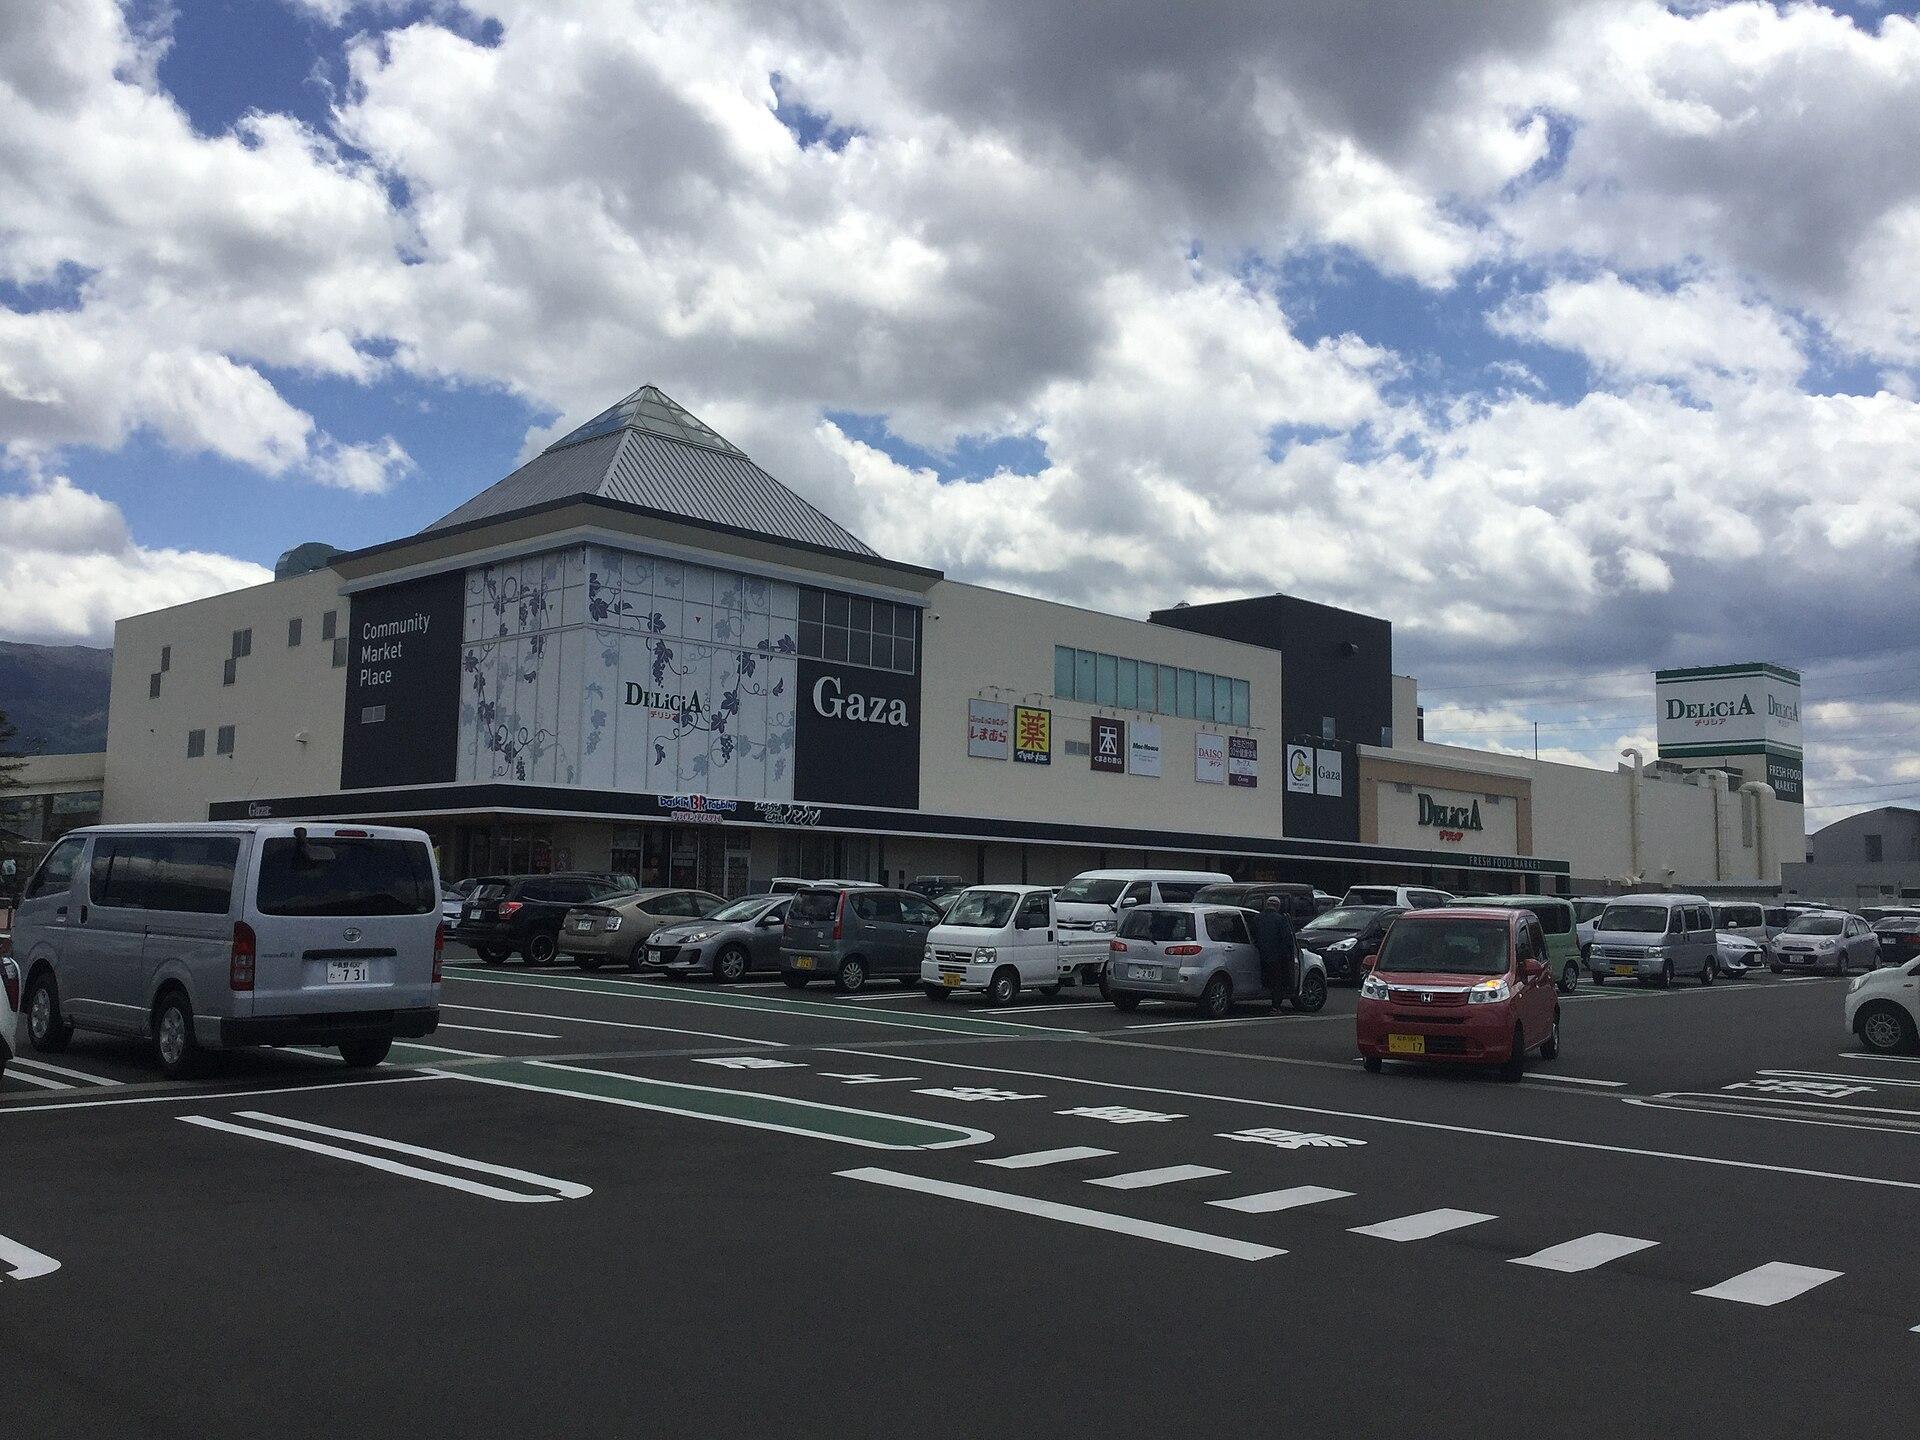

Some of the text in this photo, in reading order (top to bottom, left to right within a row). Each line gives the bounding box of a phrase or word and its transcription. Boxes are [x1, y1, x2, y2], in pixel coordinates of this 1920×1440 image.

[362, 612, 431, 640] Community
[361, 641, 402, 664] Market
[360, 669, 392, 686] Place
[812, 676, 909, 727] Gaza
[970, 726, 1007, 742] しまむら
[1021, 711, 1045, 750] 薬
[1198, 747, 1223, 760] DAISO
[1318, 765, 1341, 780] Gaza
[1769, 764, 1786, 778] FRESH
[1774, 780, 1797, 793] MARKET
[1469, 857, 1541, 870] FRESH FOOD MARKET
